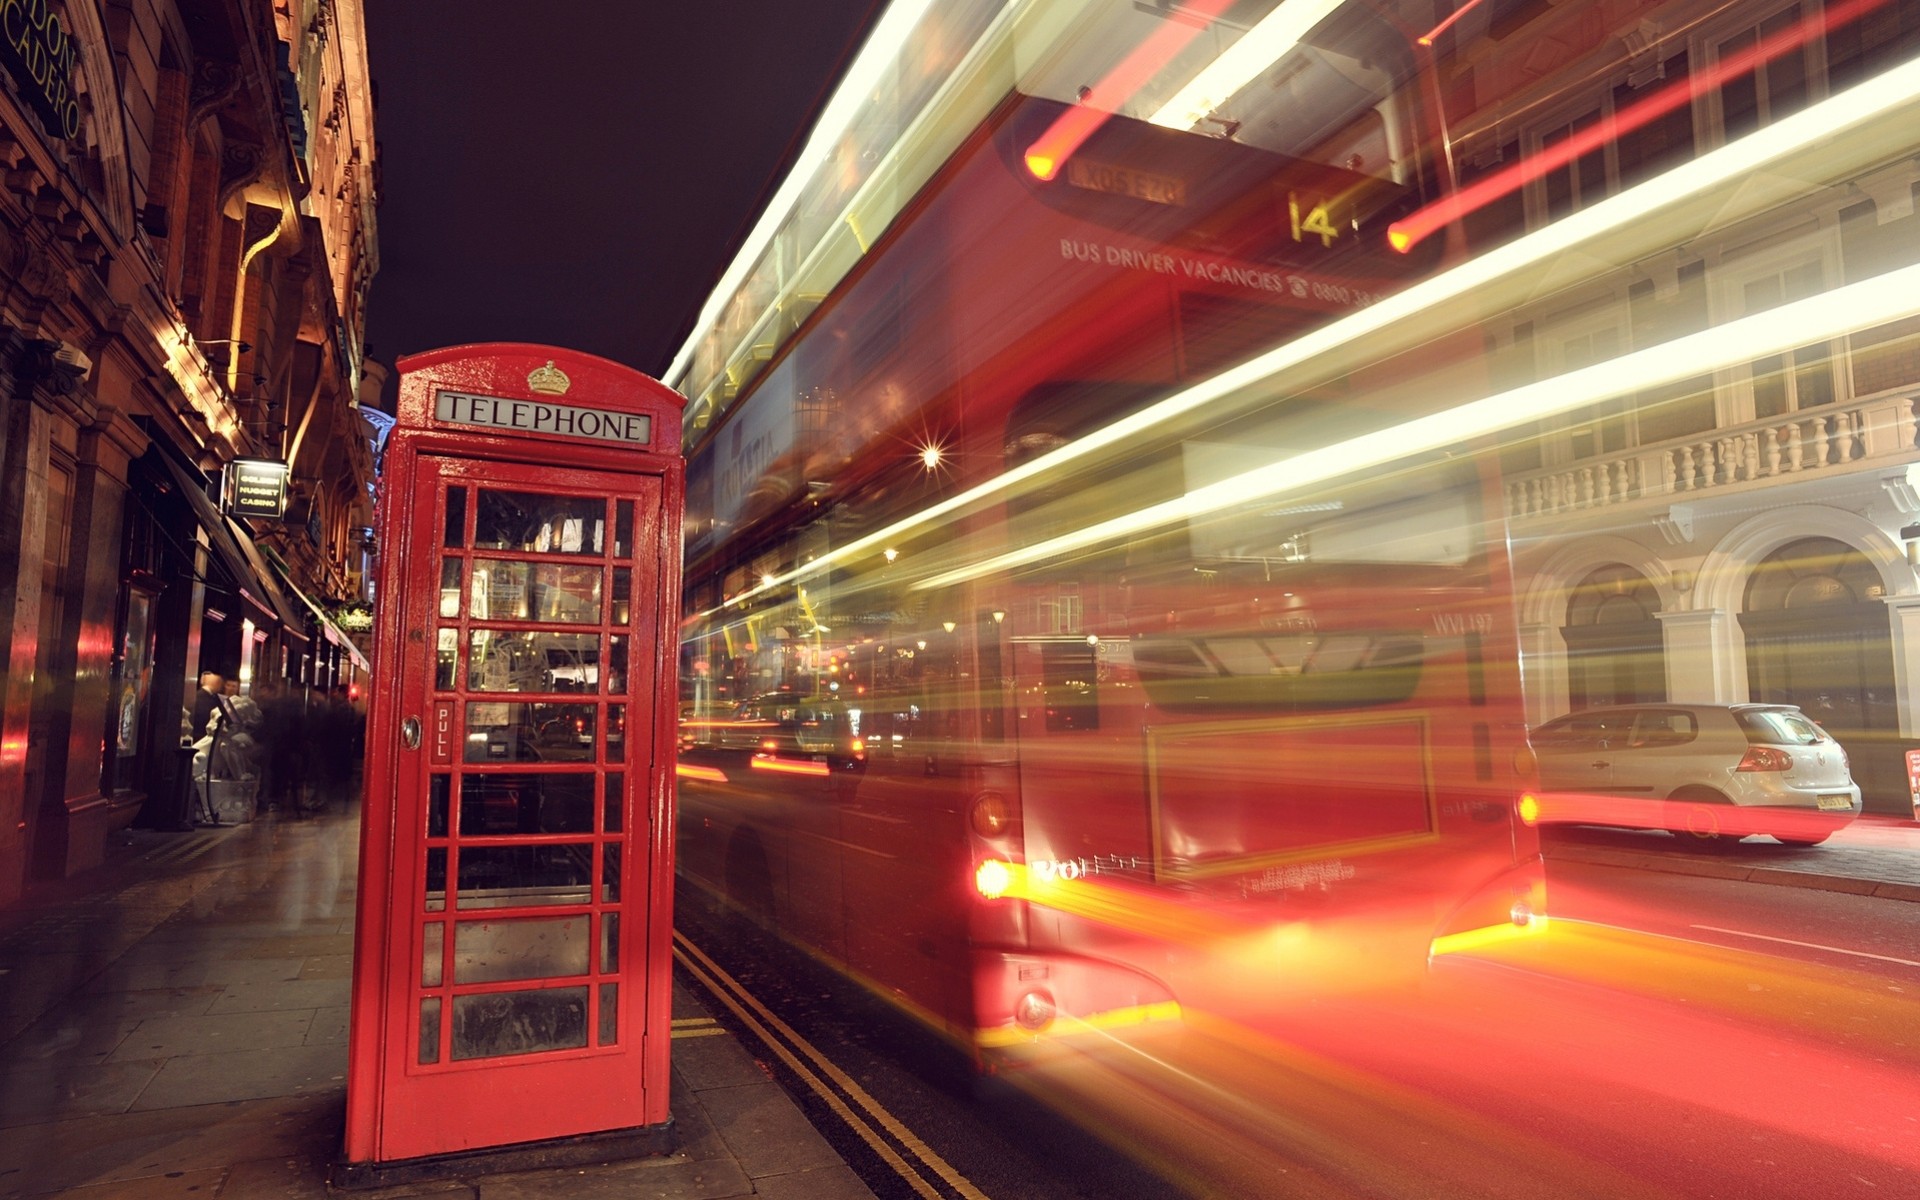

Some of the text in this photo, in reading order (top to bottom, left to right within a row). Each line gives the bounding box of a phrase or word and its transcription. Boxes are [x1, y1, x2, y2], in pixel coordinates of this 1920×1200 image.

[23, 0, 76, 82] DON
[0, 0, 79, 140] CADERO
[1288, 191, 1339, 248] 14
[1060, 239, 1101, 264] BUS
[1106, 246, 1177, 275] DRIVER
[1180, 257, 1283, 293] VACANCIES
[1312, 282, 1349, 305] 0800
[444, 395, 641, 441] TELEPHONE
[239, 486, 279, 496] NUGGET
[240, 475, 280, 486] GOLDEN
[240, 498, 276, 508] CASINO
[437, 709, 448, 756] PULL
